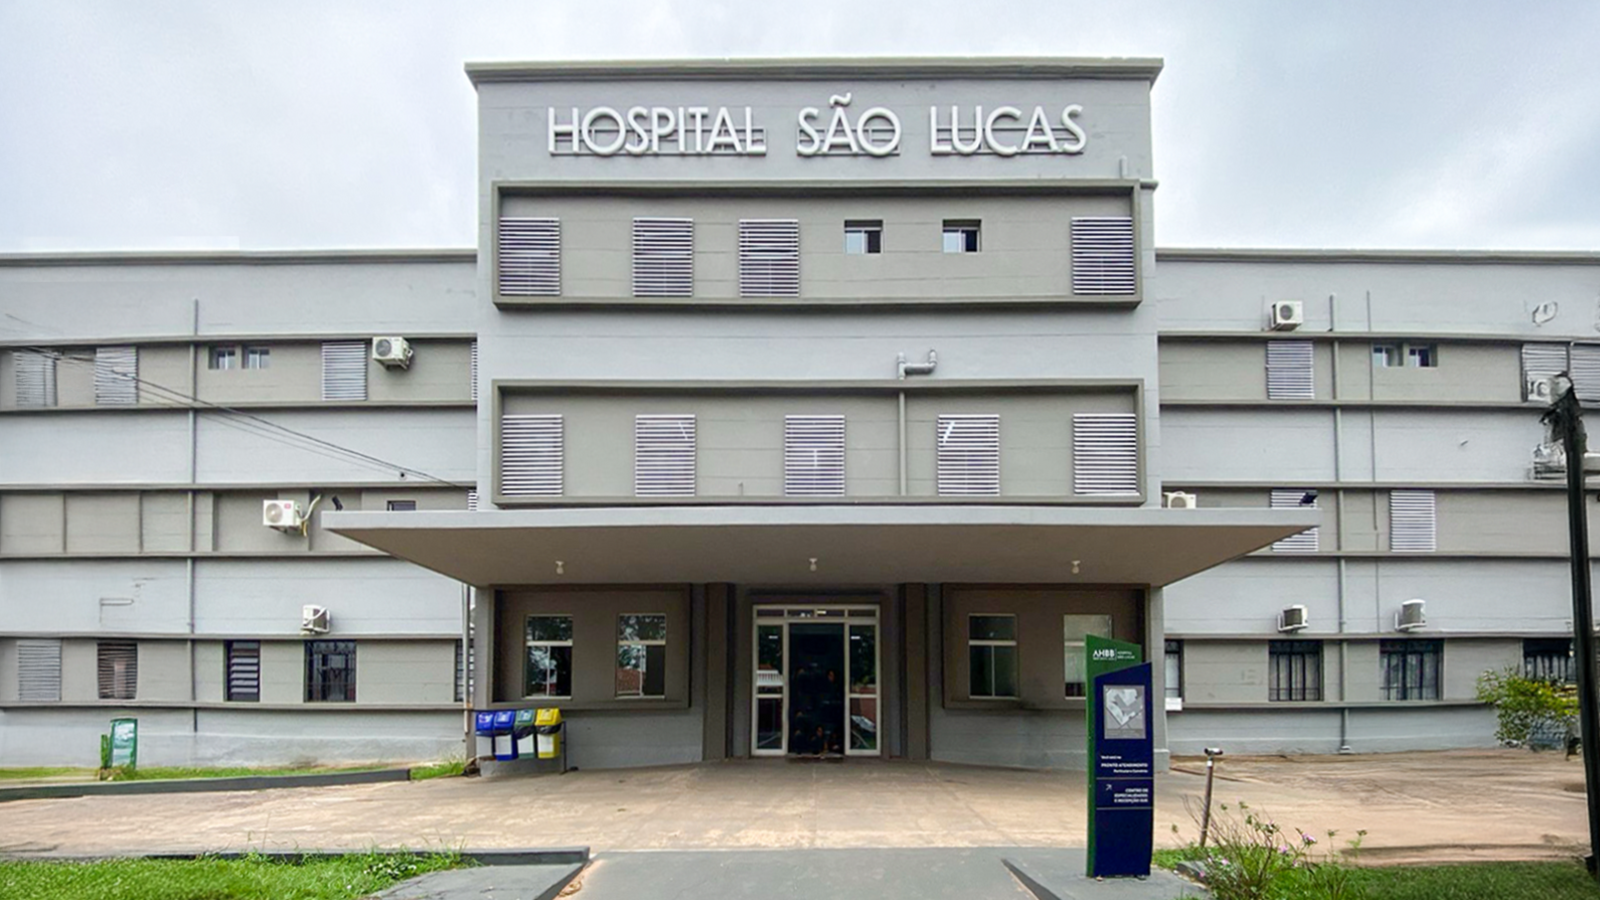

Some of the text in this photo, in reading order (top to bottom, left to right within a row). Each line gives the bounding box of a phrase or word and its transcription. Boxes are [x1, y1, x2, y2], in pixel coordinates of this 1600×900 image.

[548, 92, 1087, 156] HOSPITAL SÃO LUCAS
